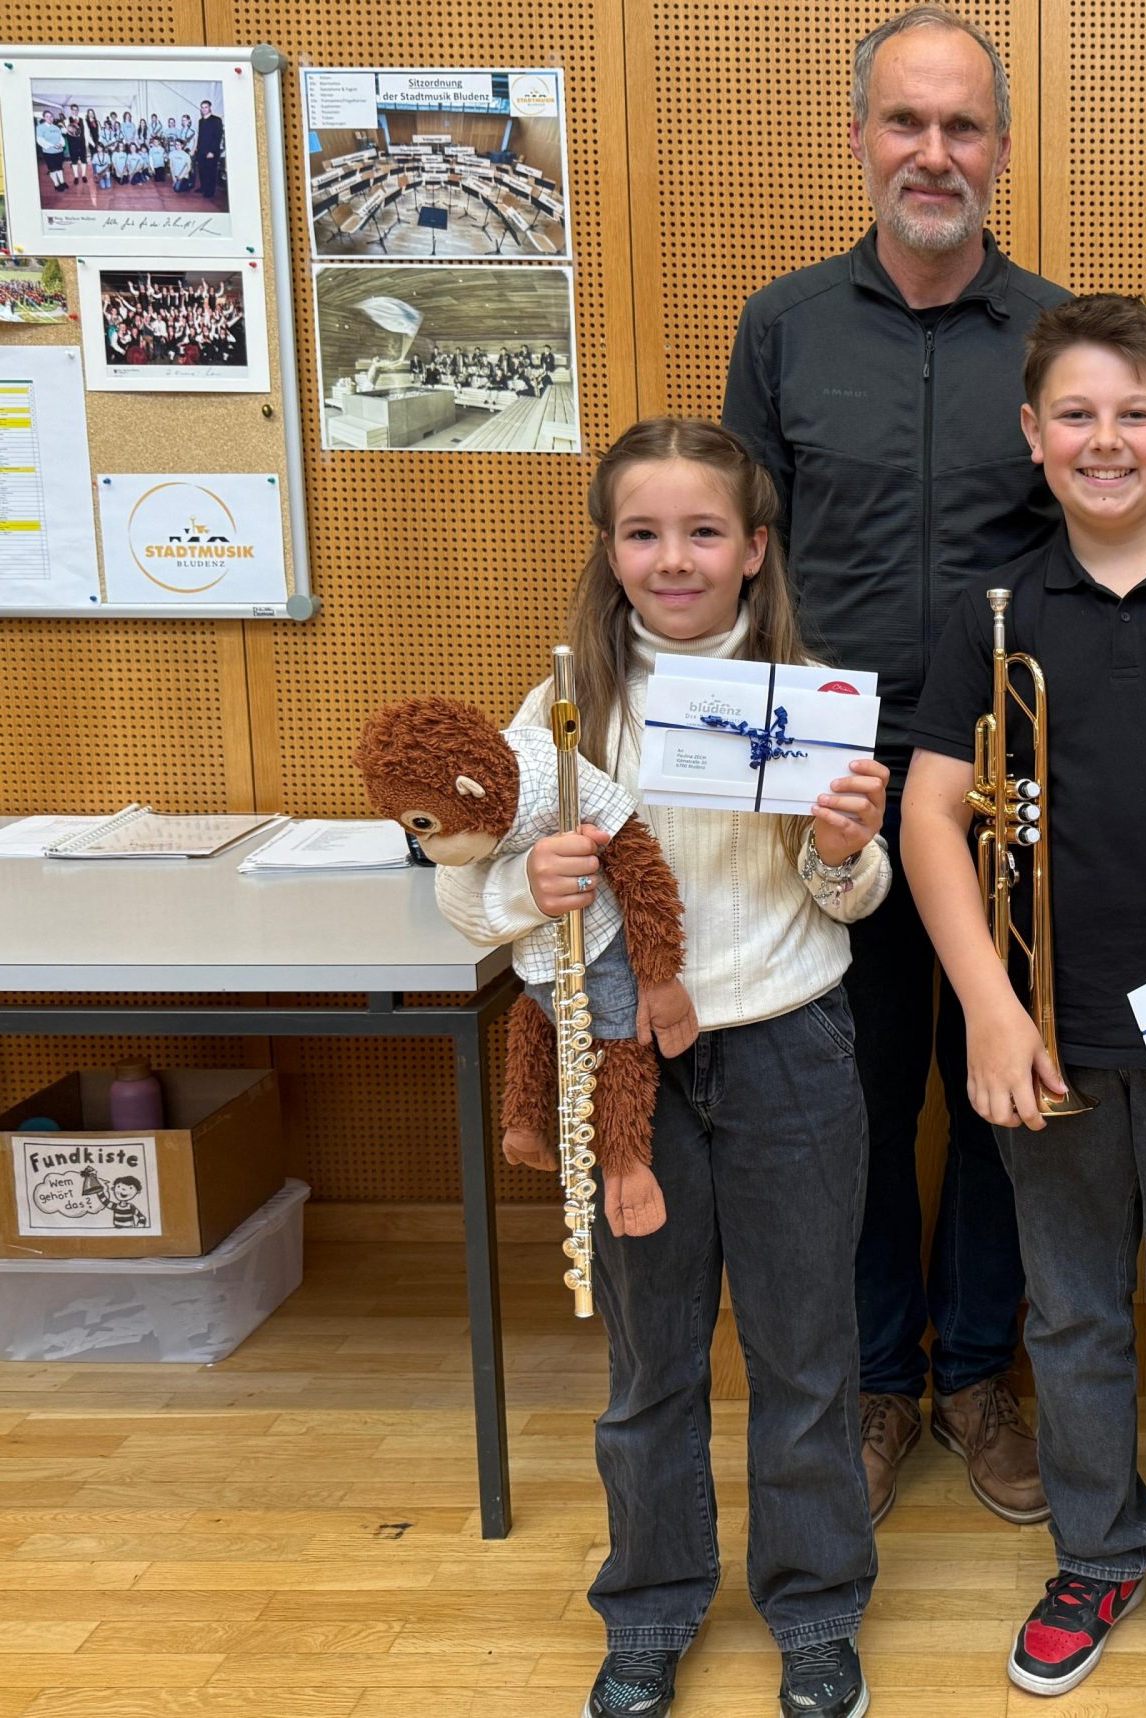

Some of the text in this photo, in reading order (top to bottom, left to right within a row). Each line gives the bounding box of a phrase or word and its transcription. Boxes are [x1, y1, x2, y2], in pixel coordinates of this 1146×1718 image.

[408, 78, 463, 89] Sitzordnung
[383, 92, 490, 101] der Stadtmusik Bludenz
[145, 545, 255, 558] STADTMUSIK
[177, 560, 226, 568] BLUDENZ
[689, 701, 742, 716] bludenz
[29, 1147, 139, 1173] Fundkiste
[49, 1179, 74, 1188] Wem
[39, 1189, 74, 1204] gehört
[65, 1197, 92, 1210] das?
